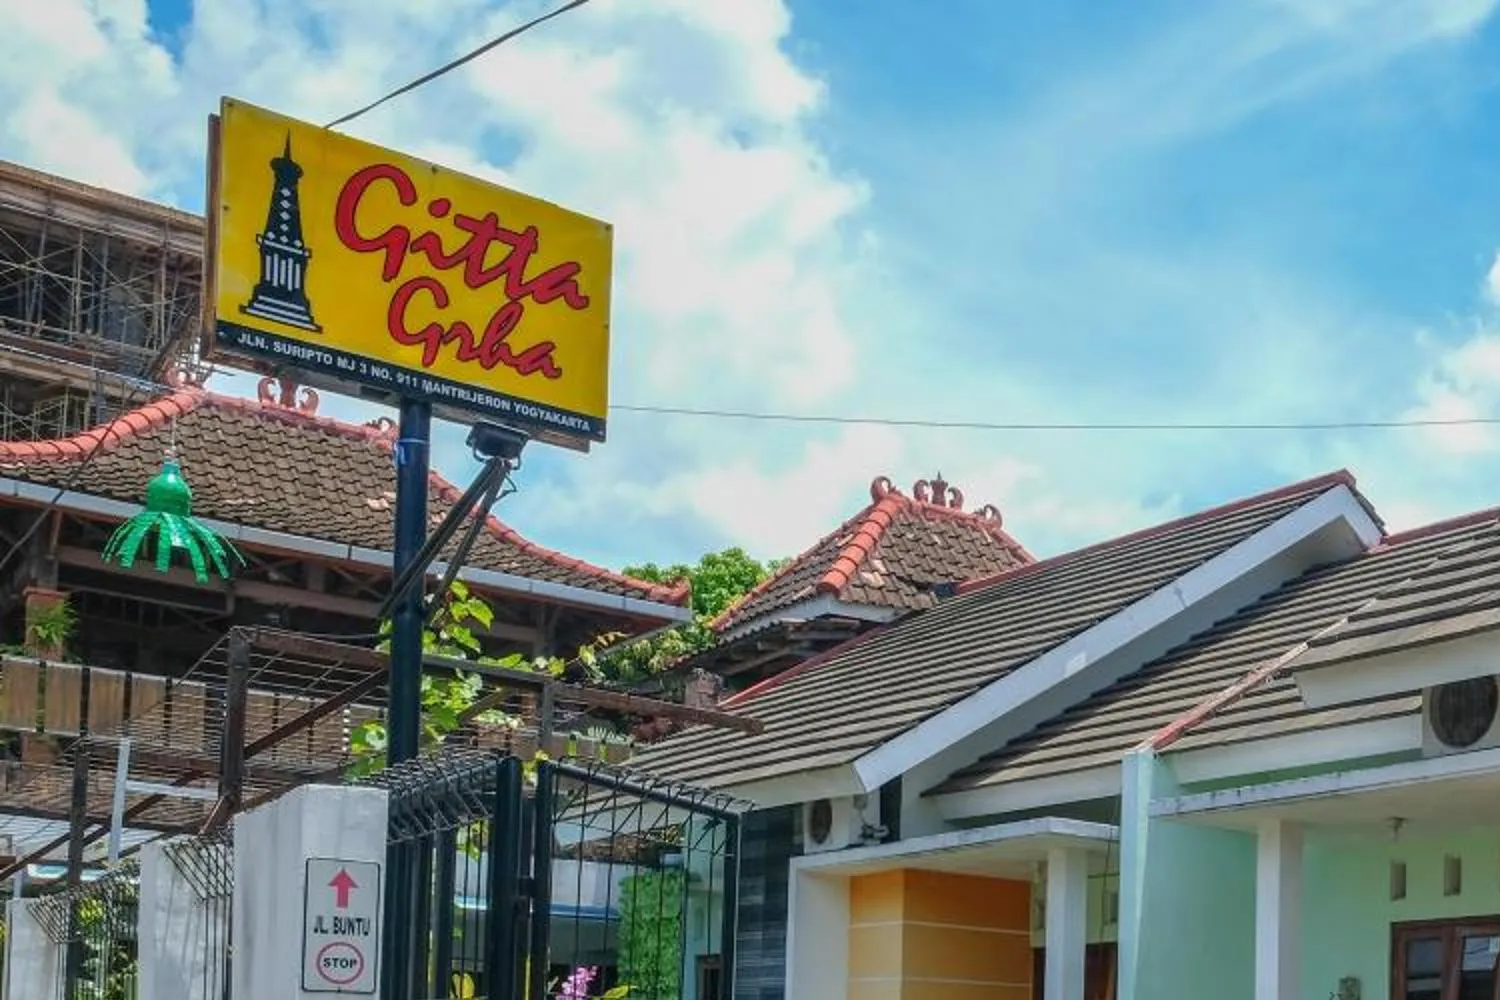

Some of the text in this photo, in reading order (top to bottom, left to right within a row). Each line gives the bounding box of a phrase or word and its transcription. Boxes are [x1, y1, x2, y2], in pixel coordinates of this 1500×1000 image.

[335, 163, 590, 310] Gitta
[238, 332, 591, 432] JLN. SURIPTO MJ 3 NO. 911 MANTRIJERON YOGYAKARTA
[333, 916, 370, 936] BUNTU
[323, 957, 358, 969] STOP
